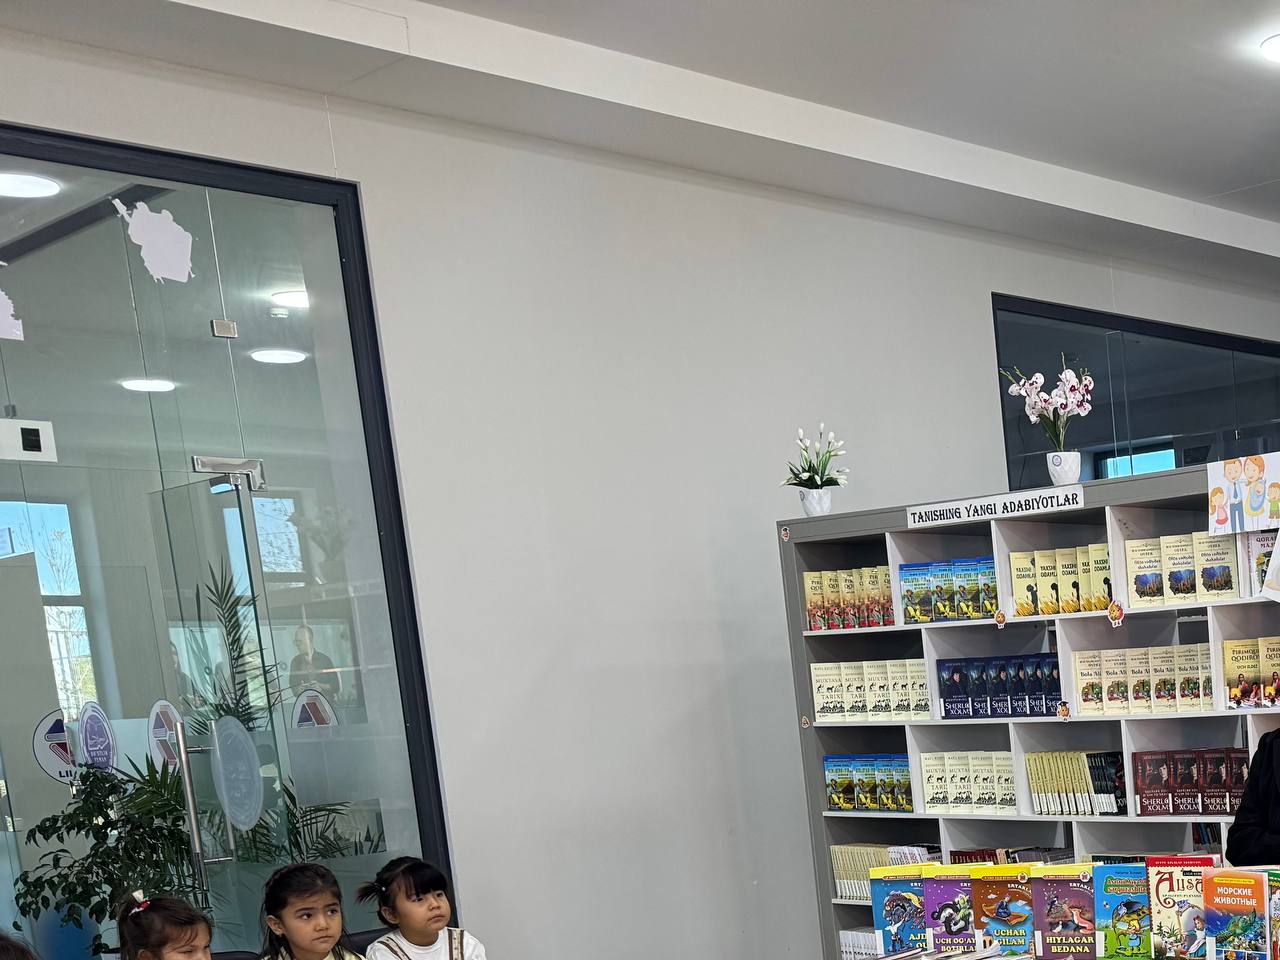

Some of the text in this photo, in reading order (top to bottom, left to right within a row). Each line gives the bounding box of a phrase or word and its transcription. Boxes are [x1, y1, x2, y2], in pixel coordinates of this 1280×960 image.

[911, 492, 1079, 524] TANISHING YANGI ADABIYOTLAR
[1217, 887, 1253, 896] МОРСКИЕ
[1213, 896, 1257, 906] ЖИВОТНЫЕ
[1046, 936, 1095, 944] HIYLAGAR
